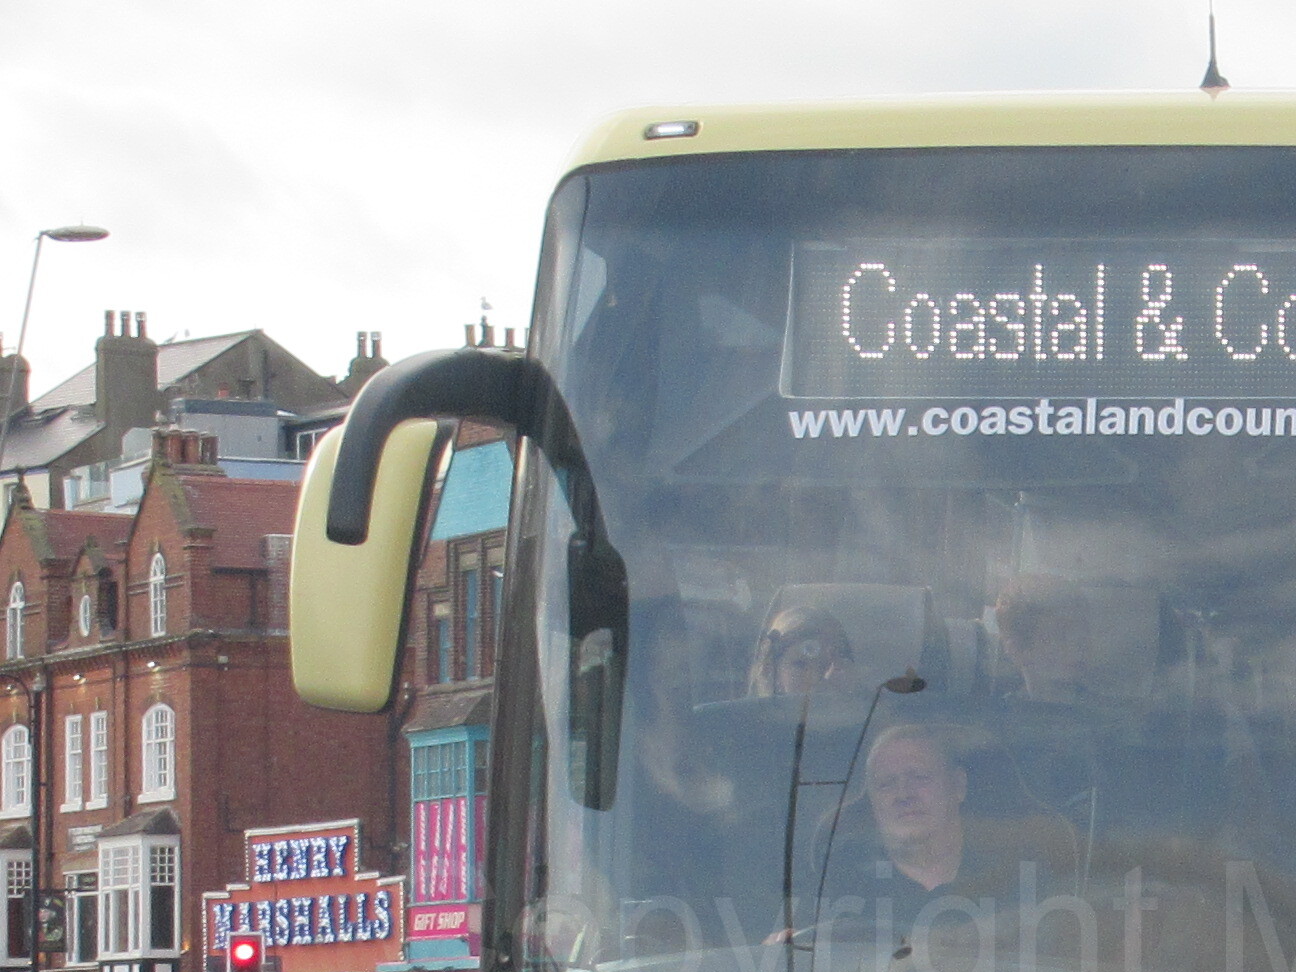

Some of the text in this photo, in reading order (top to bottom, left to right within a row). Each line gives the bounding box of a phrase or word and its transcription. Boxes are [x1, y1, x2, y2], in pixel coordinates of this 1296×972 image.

[841, 263, 1105, 360] Coastal
[1134, 263, 1188, 360] &
[252, 835, 348, 883] HENRY
[212, 890, 392, 950] MARSHALLS
[414, 911, 466, 931] GIFT SHOP
